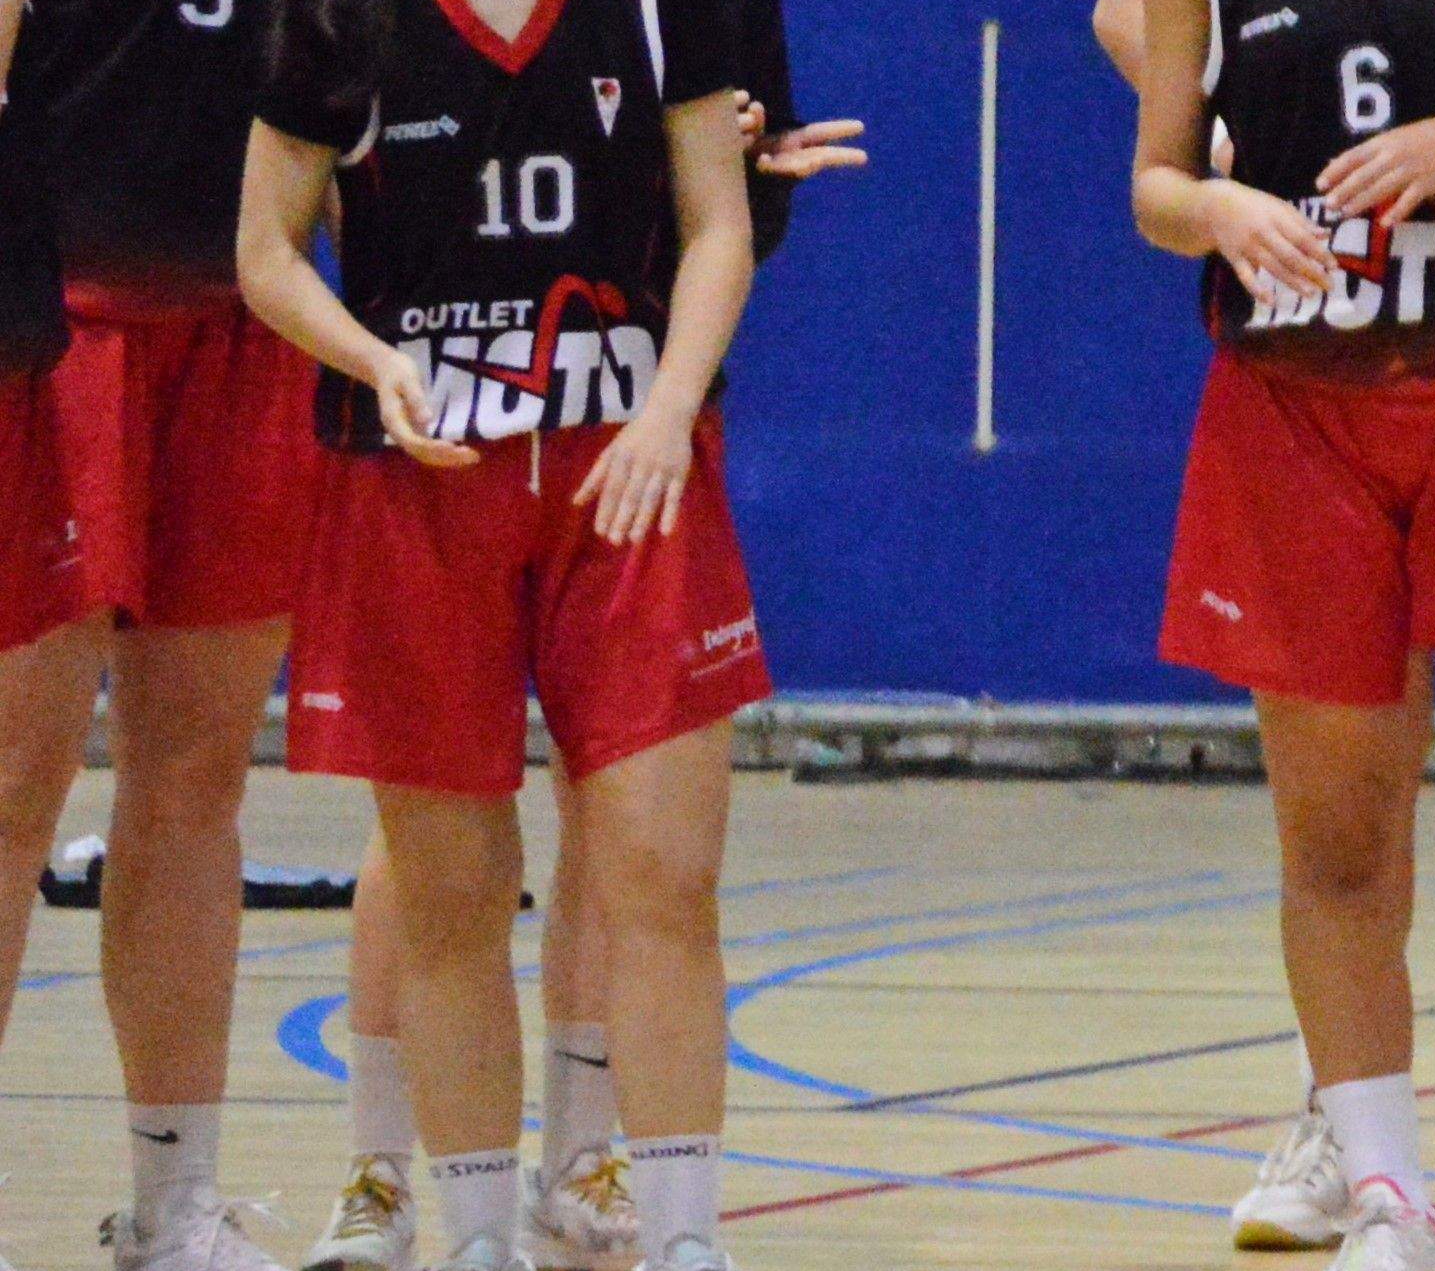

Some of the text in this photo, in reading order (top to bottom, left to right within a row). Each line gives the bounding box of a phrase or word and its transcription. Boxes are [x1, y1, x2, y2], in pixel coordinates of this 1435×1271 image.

[1340, 45, 1391, 133] 6
[477, 155, 574, 235] 10
[401, 299, 535, 333] OUTLET
